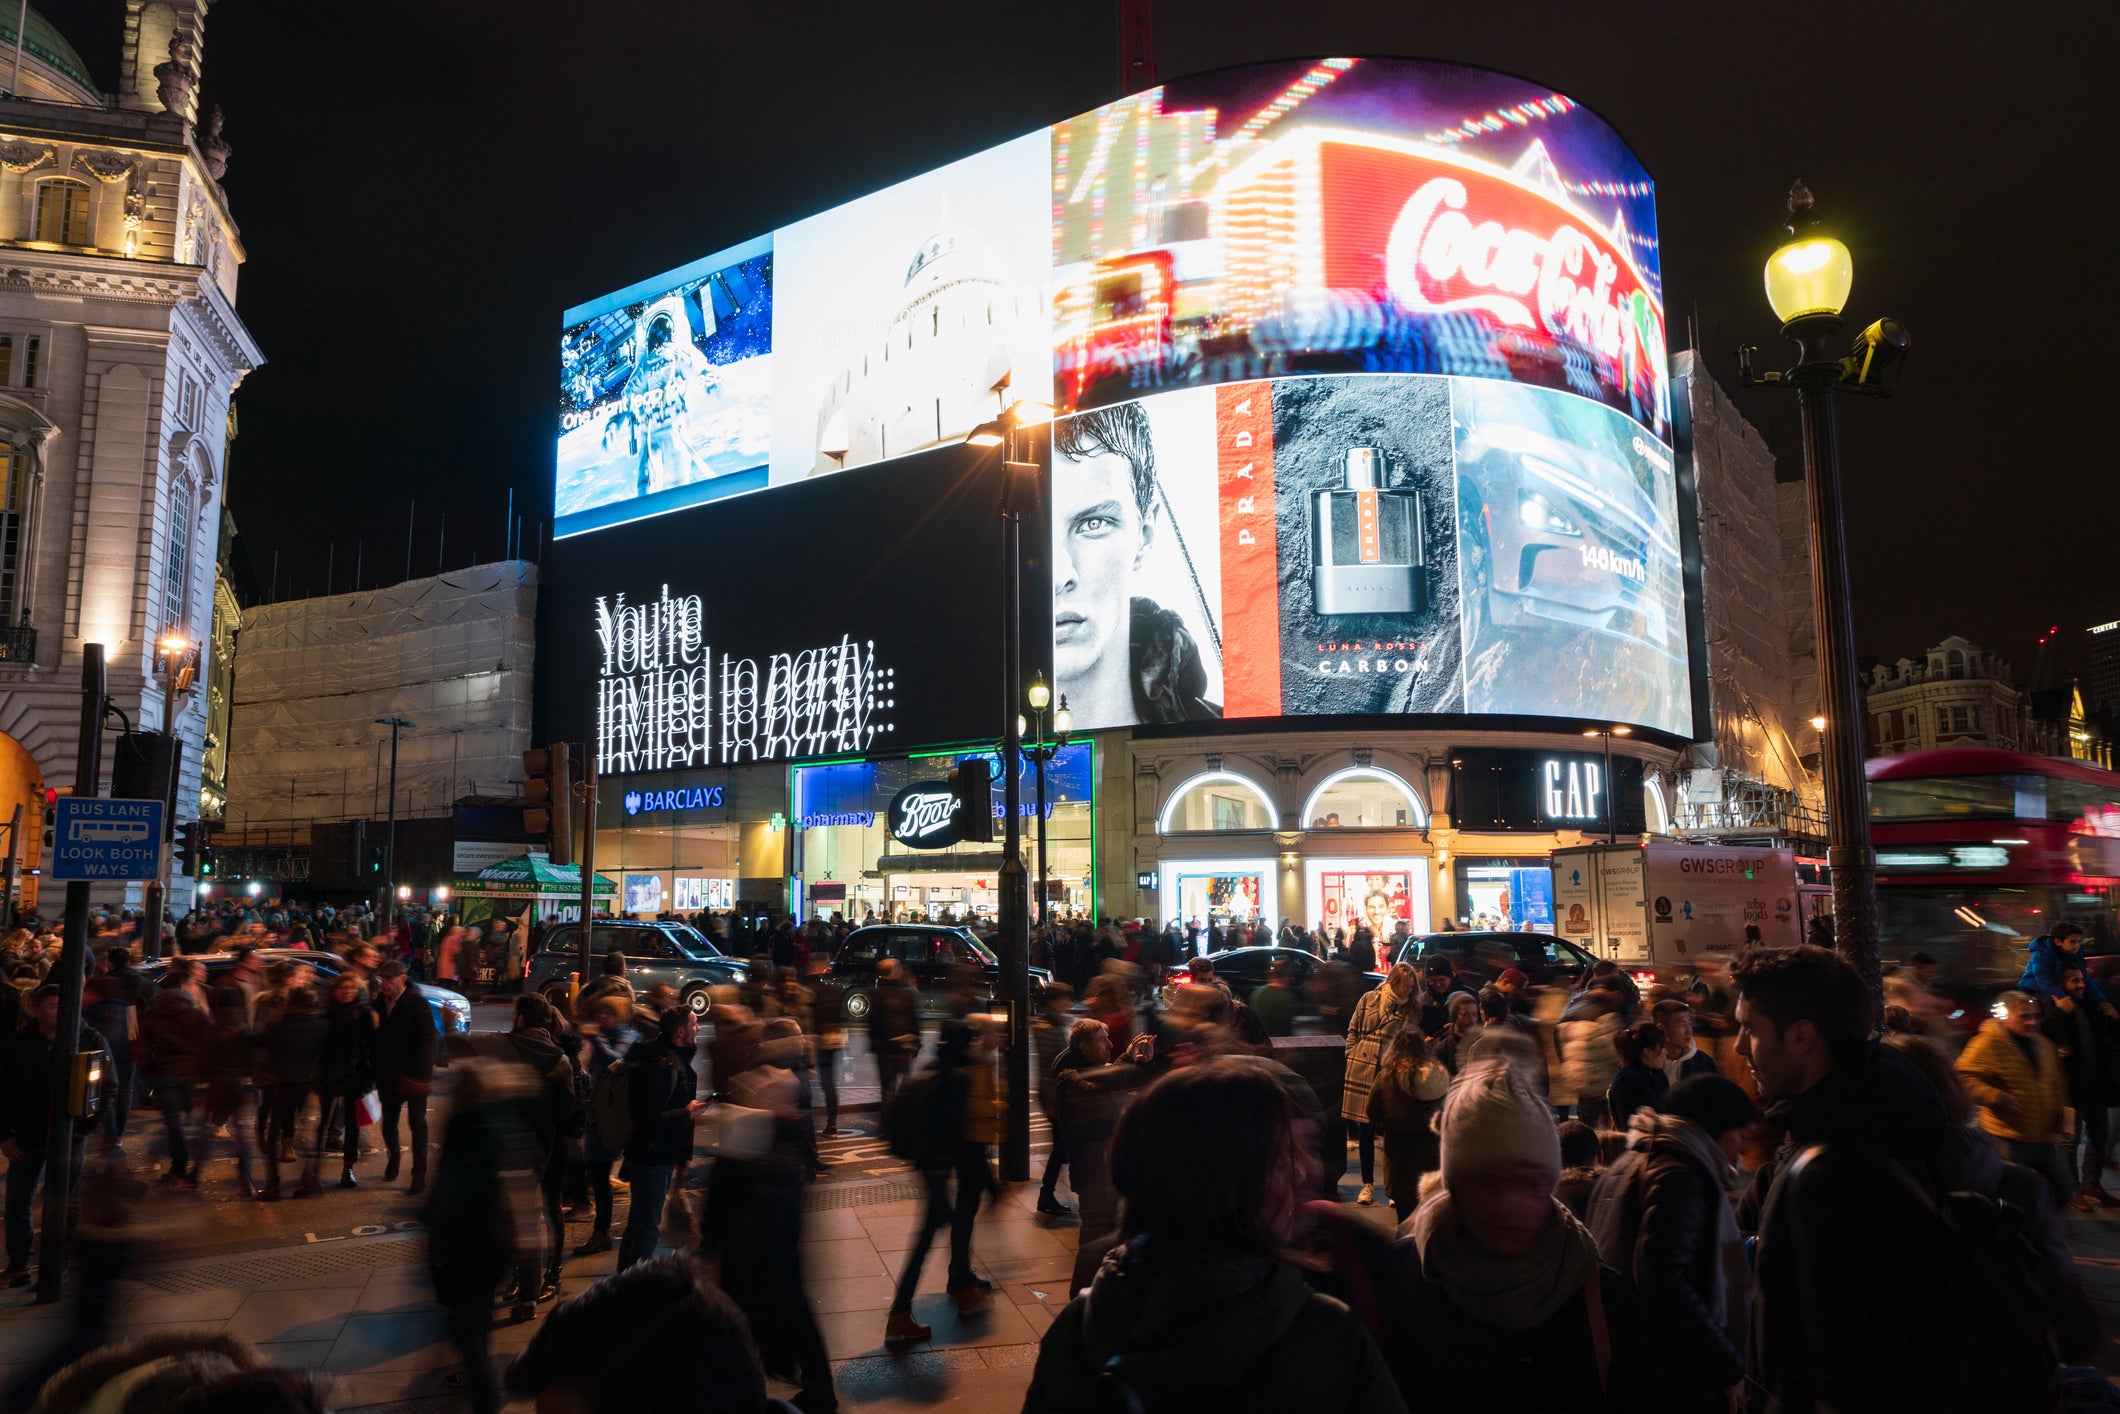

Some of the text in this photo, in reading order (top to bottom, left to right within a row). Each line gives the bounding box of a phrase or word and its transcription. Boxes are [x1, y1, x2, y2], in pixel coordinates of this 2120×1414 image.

[562, 410, 591, 430] One
[630, 387, 664, 411] leap
[1235, 398, 1256, 546] PRADA
[1363, 495, 1375, 557] PRADA
[1318, 642, 1428, 653] LUNA ROSSA
[1319, 660, 1429, 674] CARBON
[1544, 760, 1600, 818] GAP
[644, 786, 724, 811] BARCLAYS
[70, 803, 151, 817] BUS LANE
[995, 801, 1054, 820] bauy
[804, 811, 876, 829] pharmacy
[60, 848, 153, 860] LOOK BOTH
[84, 865, 129, 876] WAYS
[1139, 876, 1151, 885] GAP
